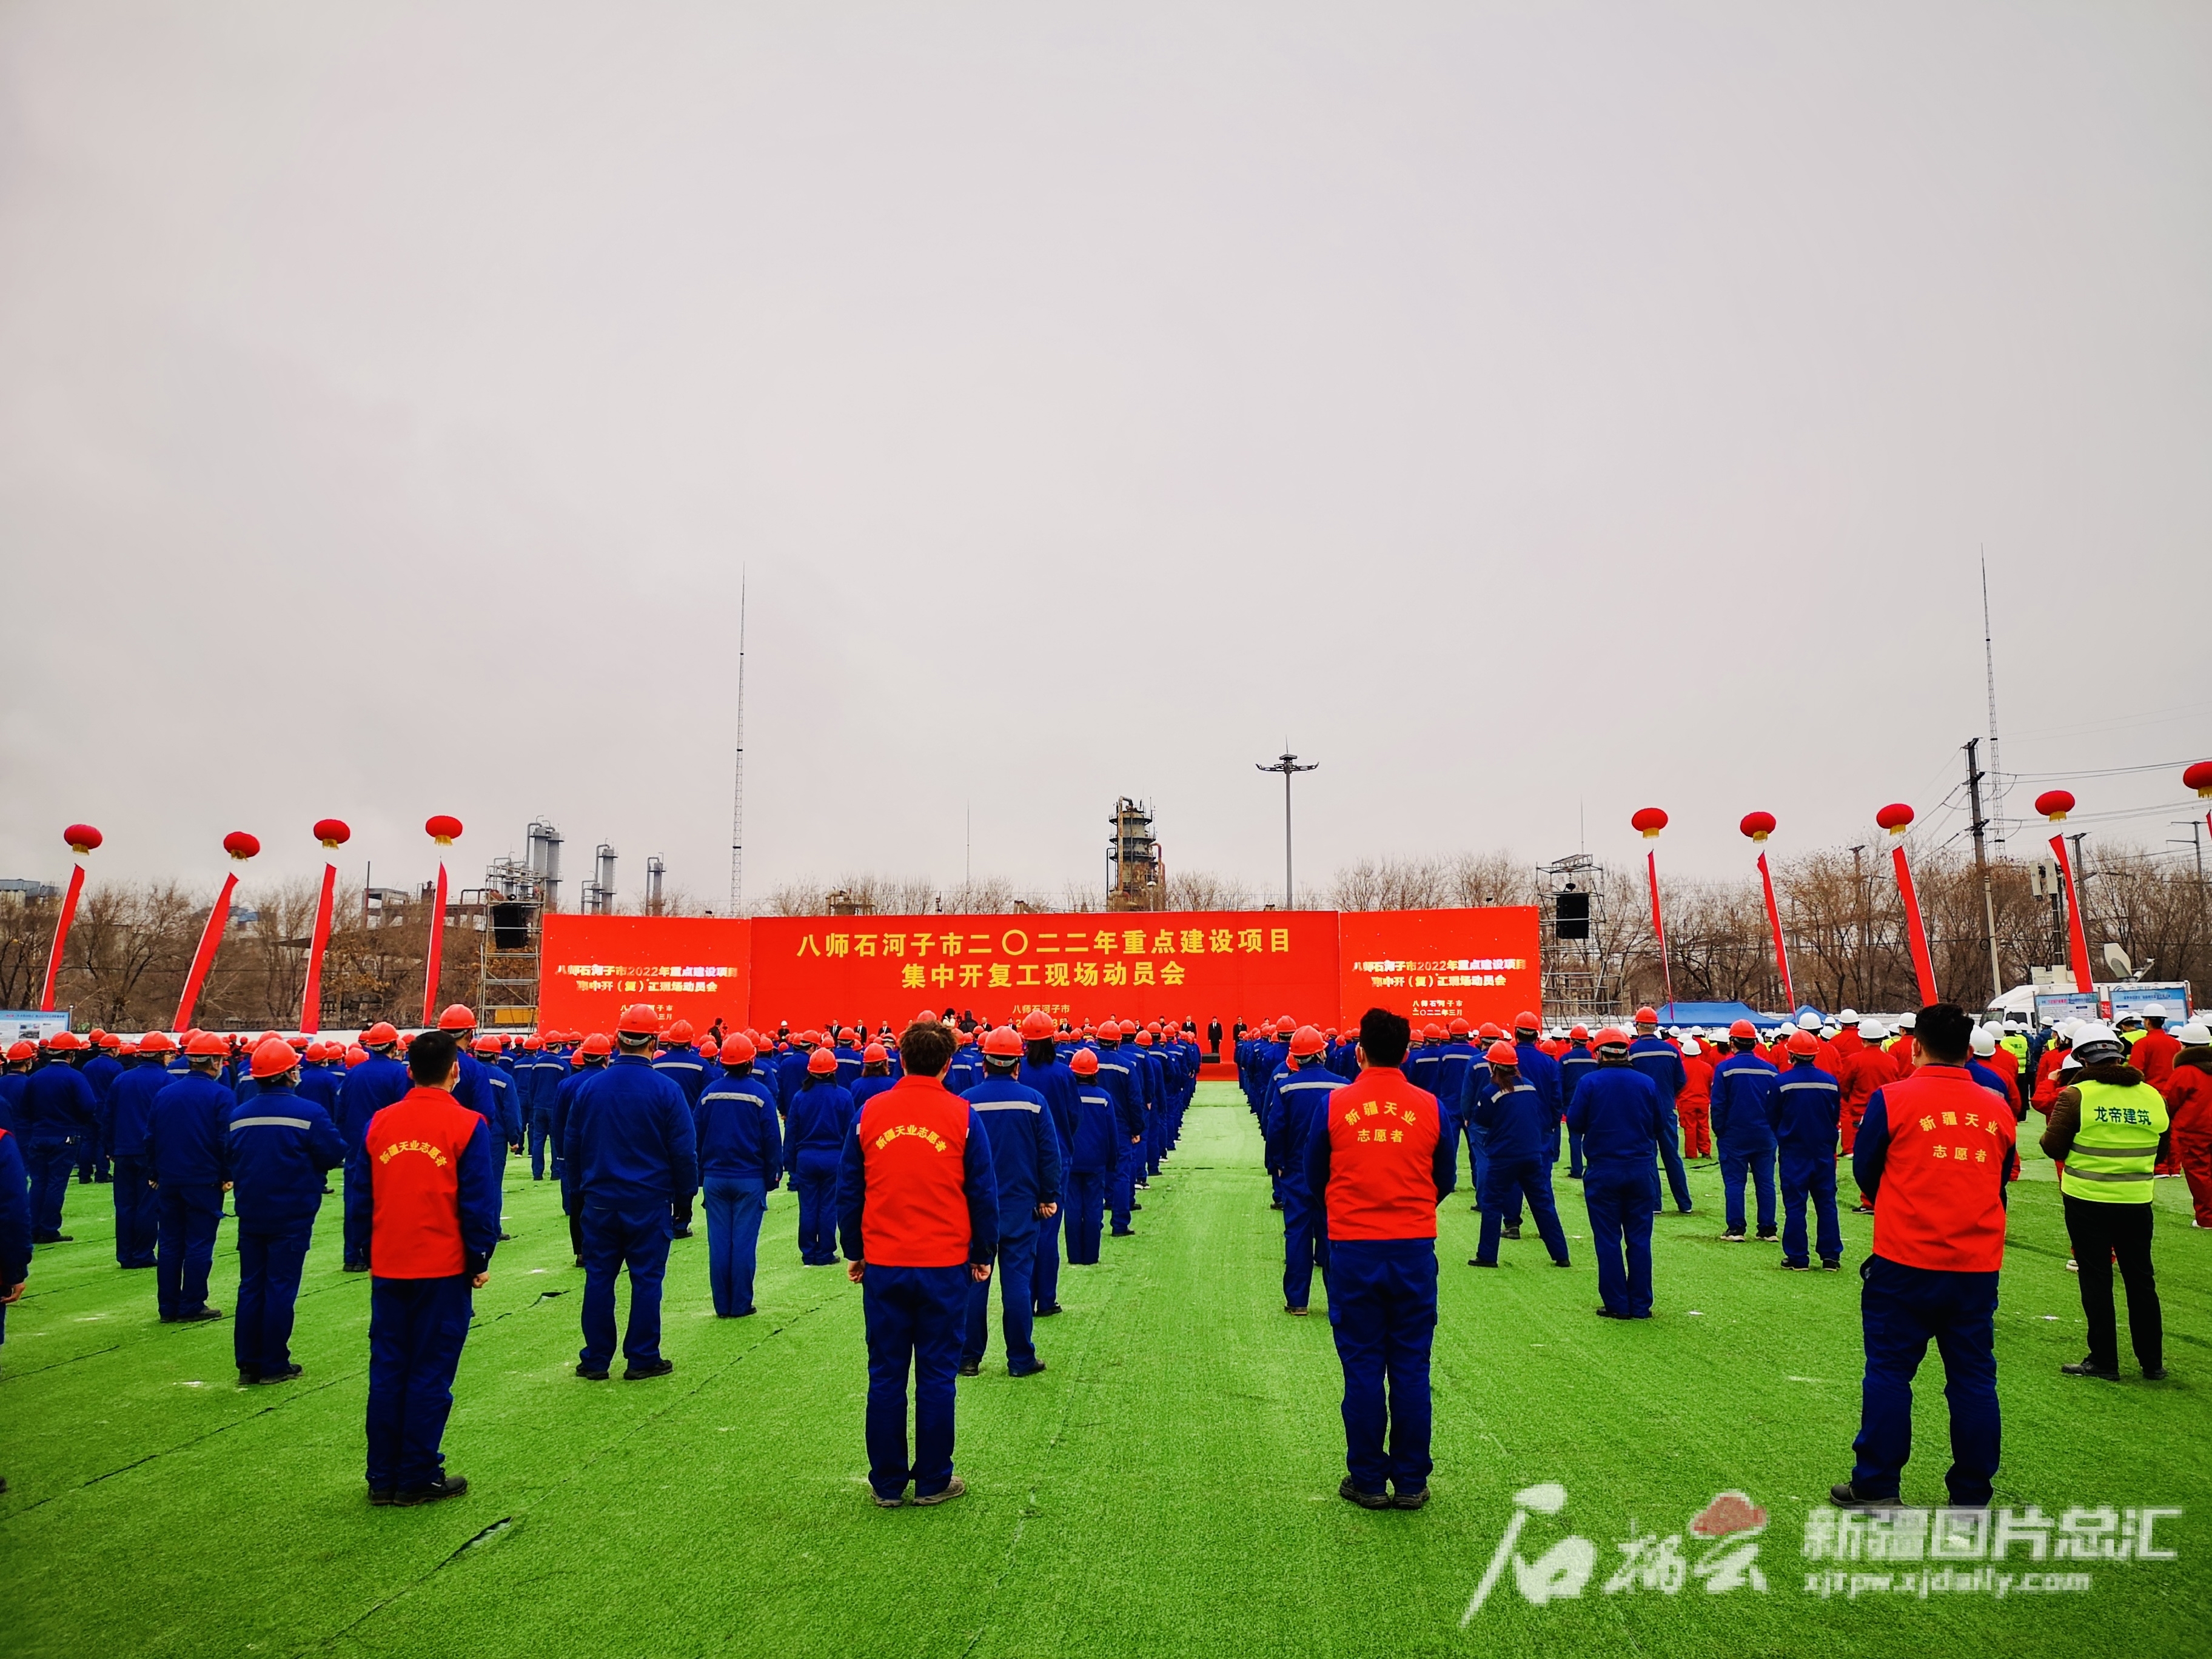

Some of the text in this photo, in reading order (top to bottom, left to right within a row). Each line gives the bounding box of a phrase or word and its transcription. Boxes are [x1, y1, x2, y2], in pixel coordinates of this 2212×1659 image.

[901, 960, 1186, 989] 集中开复工现场动员会
[1344, 1101, 1416, 1126] 新疆天业
[1919, 1111, 1998, 1136] 新疆天业
[2094, 1106, 2152, 1126] 龙帝建筑
[876, 1124, 947, 1152] 新疆天业志愿者
[1357, 1128, 1404, 1143] 志愿者
[380, 1140, 447, 1167] 新疆天业志愿者
[1933, 1144, 1987, 1162] 志愿者
